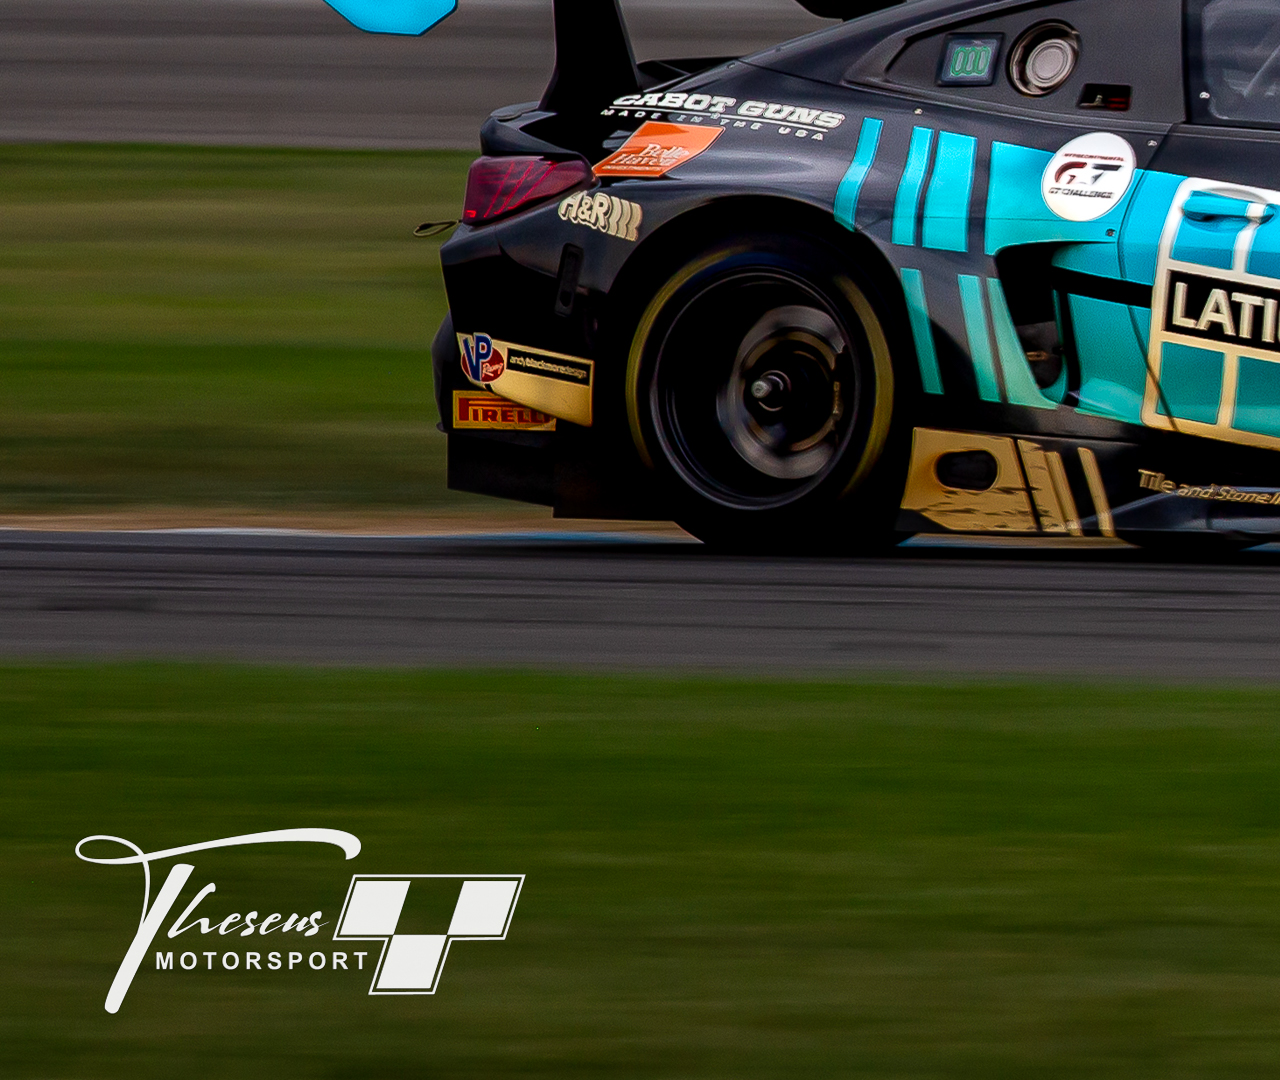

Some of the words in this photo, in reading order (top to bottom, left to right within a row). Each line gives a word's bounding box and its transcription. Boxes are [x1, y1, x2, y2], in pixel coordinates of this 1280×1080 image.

[600, 109, 662, 120] MADE
[677, 114, 703, 123] IN
[778, 126, 824, 141] USA
[613, 92, 736, 113] CABOT
[737, 100, 846, 128] GUNS
[462, 332, 493, 383] VP
[1138, 469, 1177, 495] Tile
[1177, 483, 1214, 499] and
[1216, 485, 1270, 505] Stone
